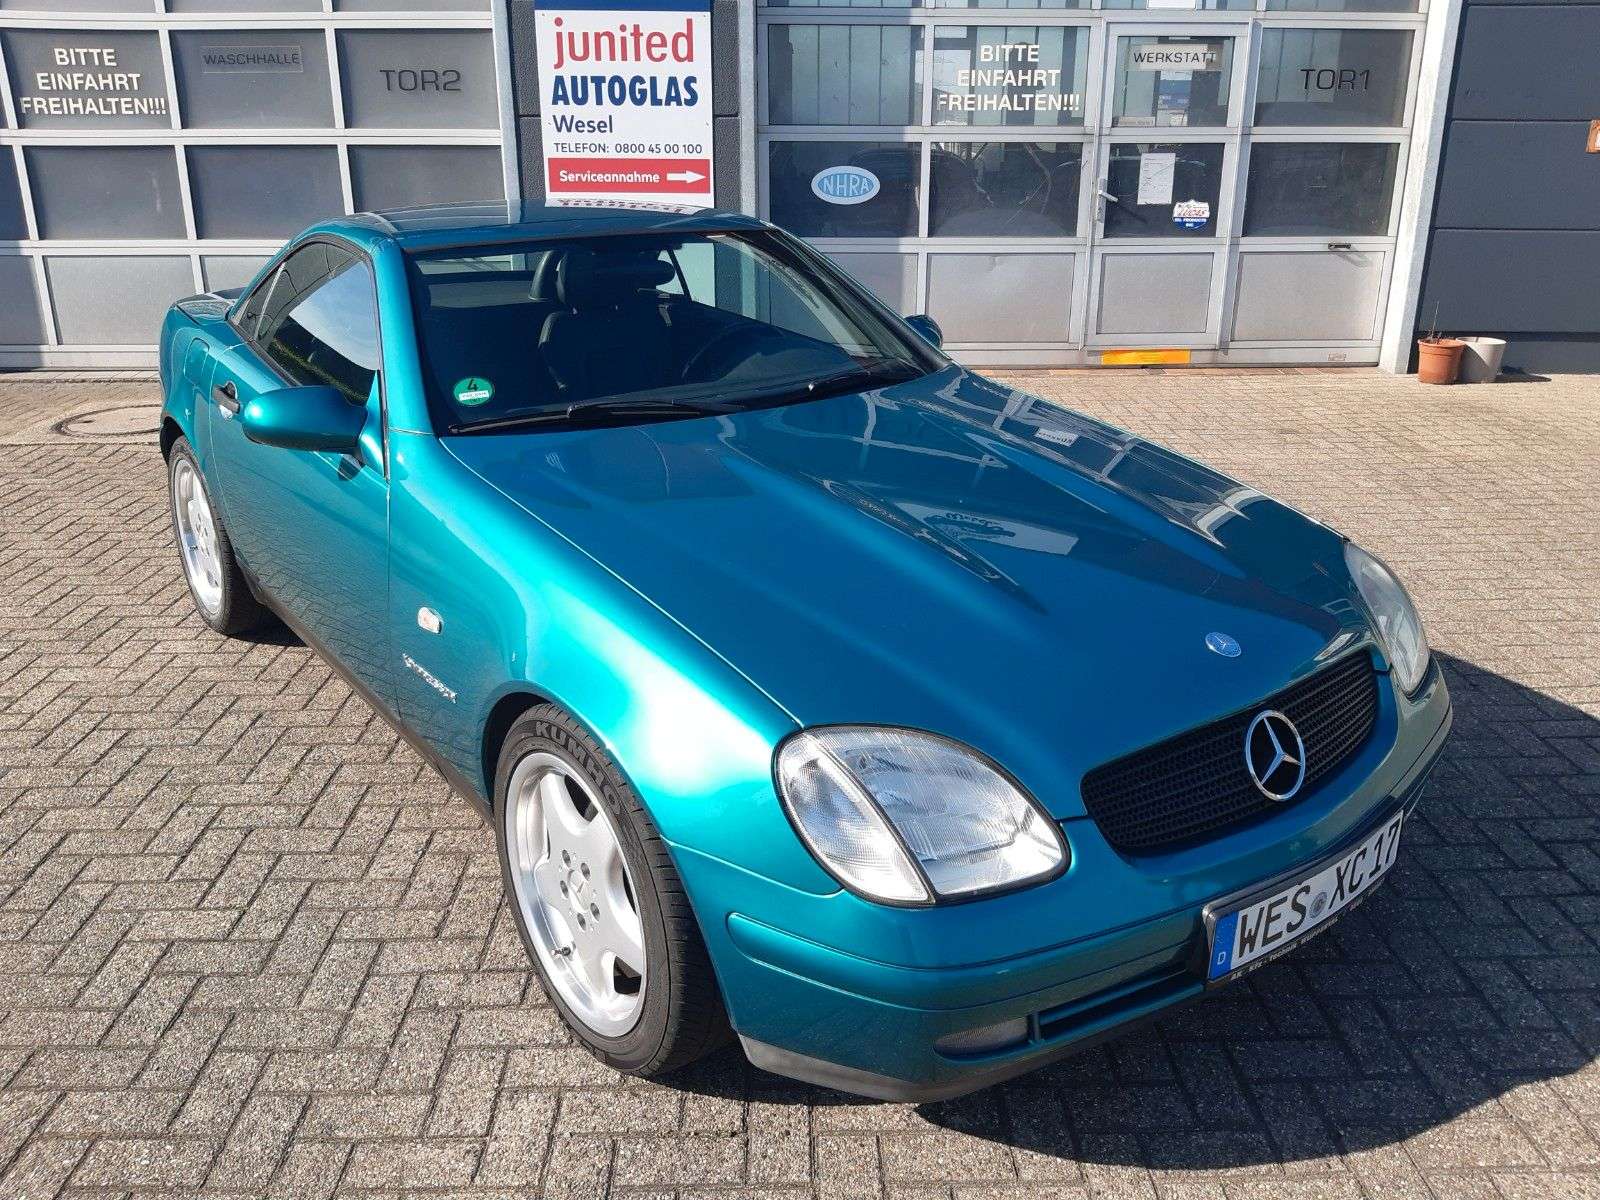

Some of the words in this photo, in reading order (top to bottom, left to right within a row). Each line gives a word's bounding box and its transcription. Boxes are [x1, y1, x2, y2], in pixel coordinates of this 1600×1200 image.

[553, 17, 694, 70] junited
[54, 47, 118, 67] BITTE
[203, 53, 301, 66] WASCHHALLE
[980, 44, 1041, 62] BITTE
[1133, 52, 1217, 63] WERKSTATT
[36, 73, 141, 91] EINFAHRT
[380, 69, 463, 92] TOR2
[957, 69, 1061, 87] EINFAHRT
[1300, 69, 1370, 90] TOR1
[552, 75, 699, 107] AUTOGLAS
[20, 97, 166, 115] FREIHALTEN!!!
[936, 94, 1080, 111] FREIHALTEN!!!
[552, 115, 614, 134] Wesel
[554, 142, 610, 154] TELEFON:
[614, 143, 645, 154] 0800
[648, 143, 661, 154] 45
[664, 143, 680, 154] 00
[682, 143, 703, 154] 100
[559, 170, 661, 183] Serviceannahme
[822, 174, 872, 198] NHRA
[467, 379, 479, 391] 4
[535, 721, 623, 816] KUMHO
[1238, 885, 1310, 958] WES
[1328, 846, 1366, 910] XC
[1368, 817, 1402, 879] 17
[1217, 952, 1227, 965] D
